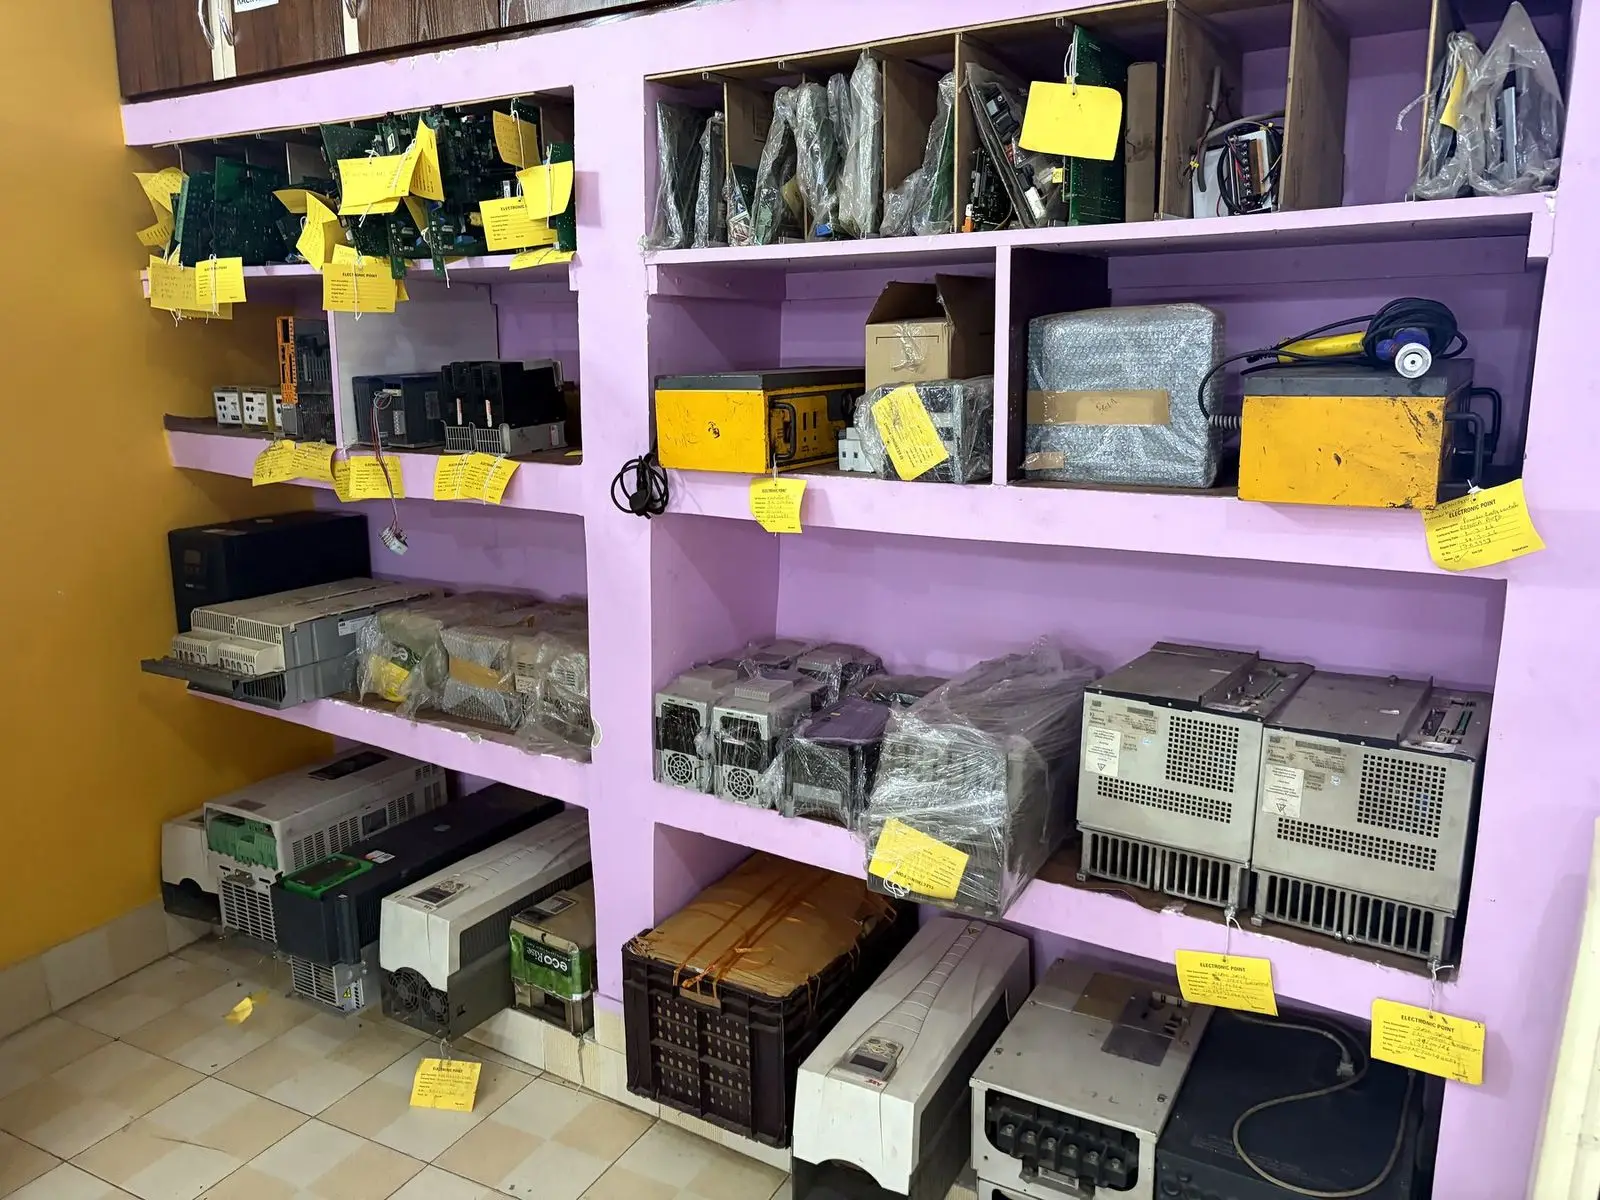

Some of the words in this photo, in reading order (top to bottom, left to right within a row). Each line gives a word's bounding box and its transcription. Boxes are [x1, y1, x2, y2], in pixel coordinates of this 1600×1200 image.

[1448, 504, 1479, 518] ELECTRONIC
[1480, 499, 1496, 508] POINT
[1200, 962, 1230, 971] ELECTRONIC
[1401, 1014, 1436, 1028] ELECTRONIC
[1437, 1023, 1455, 1033] POINT
